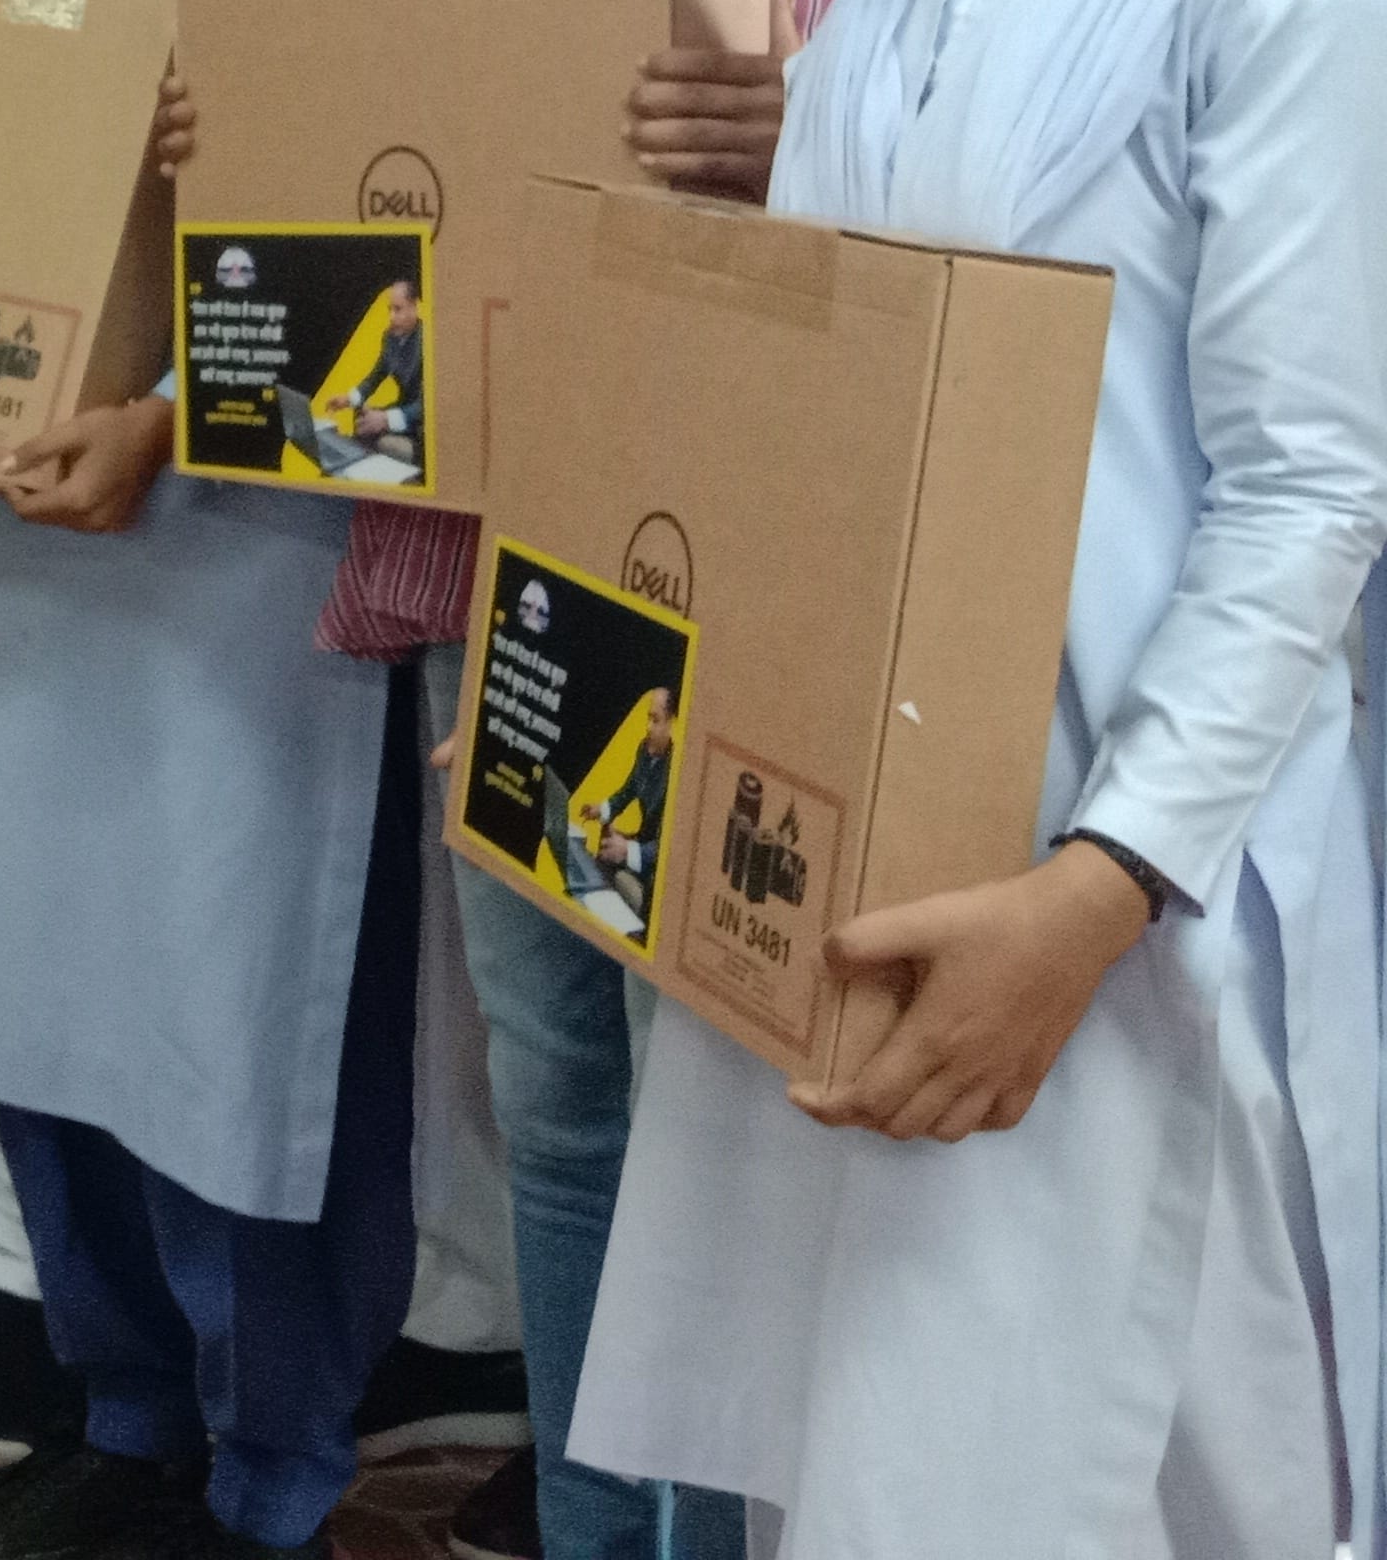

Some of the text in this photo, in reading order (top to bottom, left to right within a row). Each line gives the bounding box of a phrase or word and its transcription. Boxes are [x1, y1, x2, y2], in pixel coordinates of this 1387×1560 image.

[369, 190, 435, 218] DELL
[630, 559, 683, 612] DELL
[712, 894, 792, 968] UN 3481
